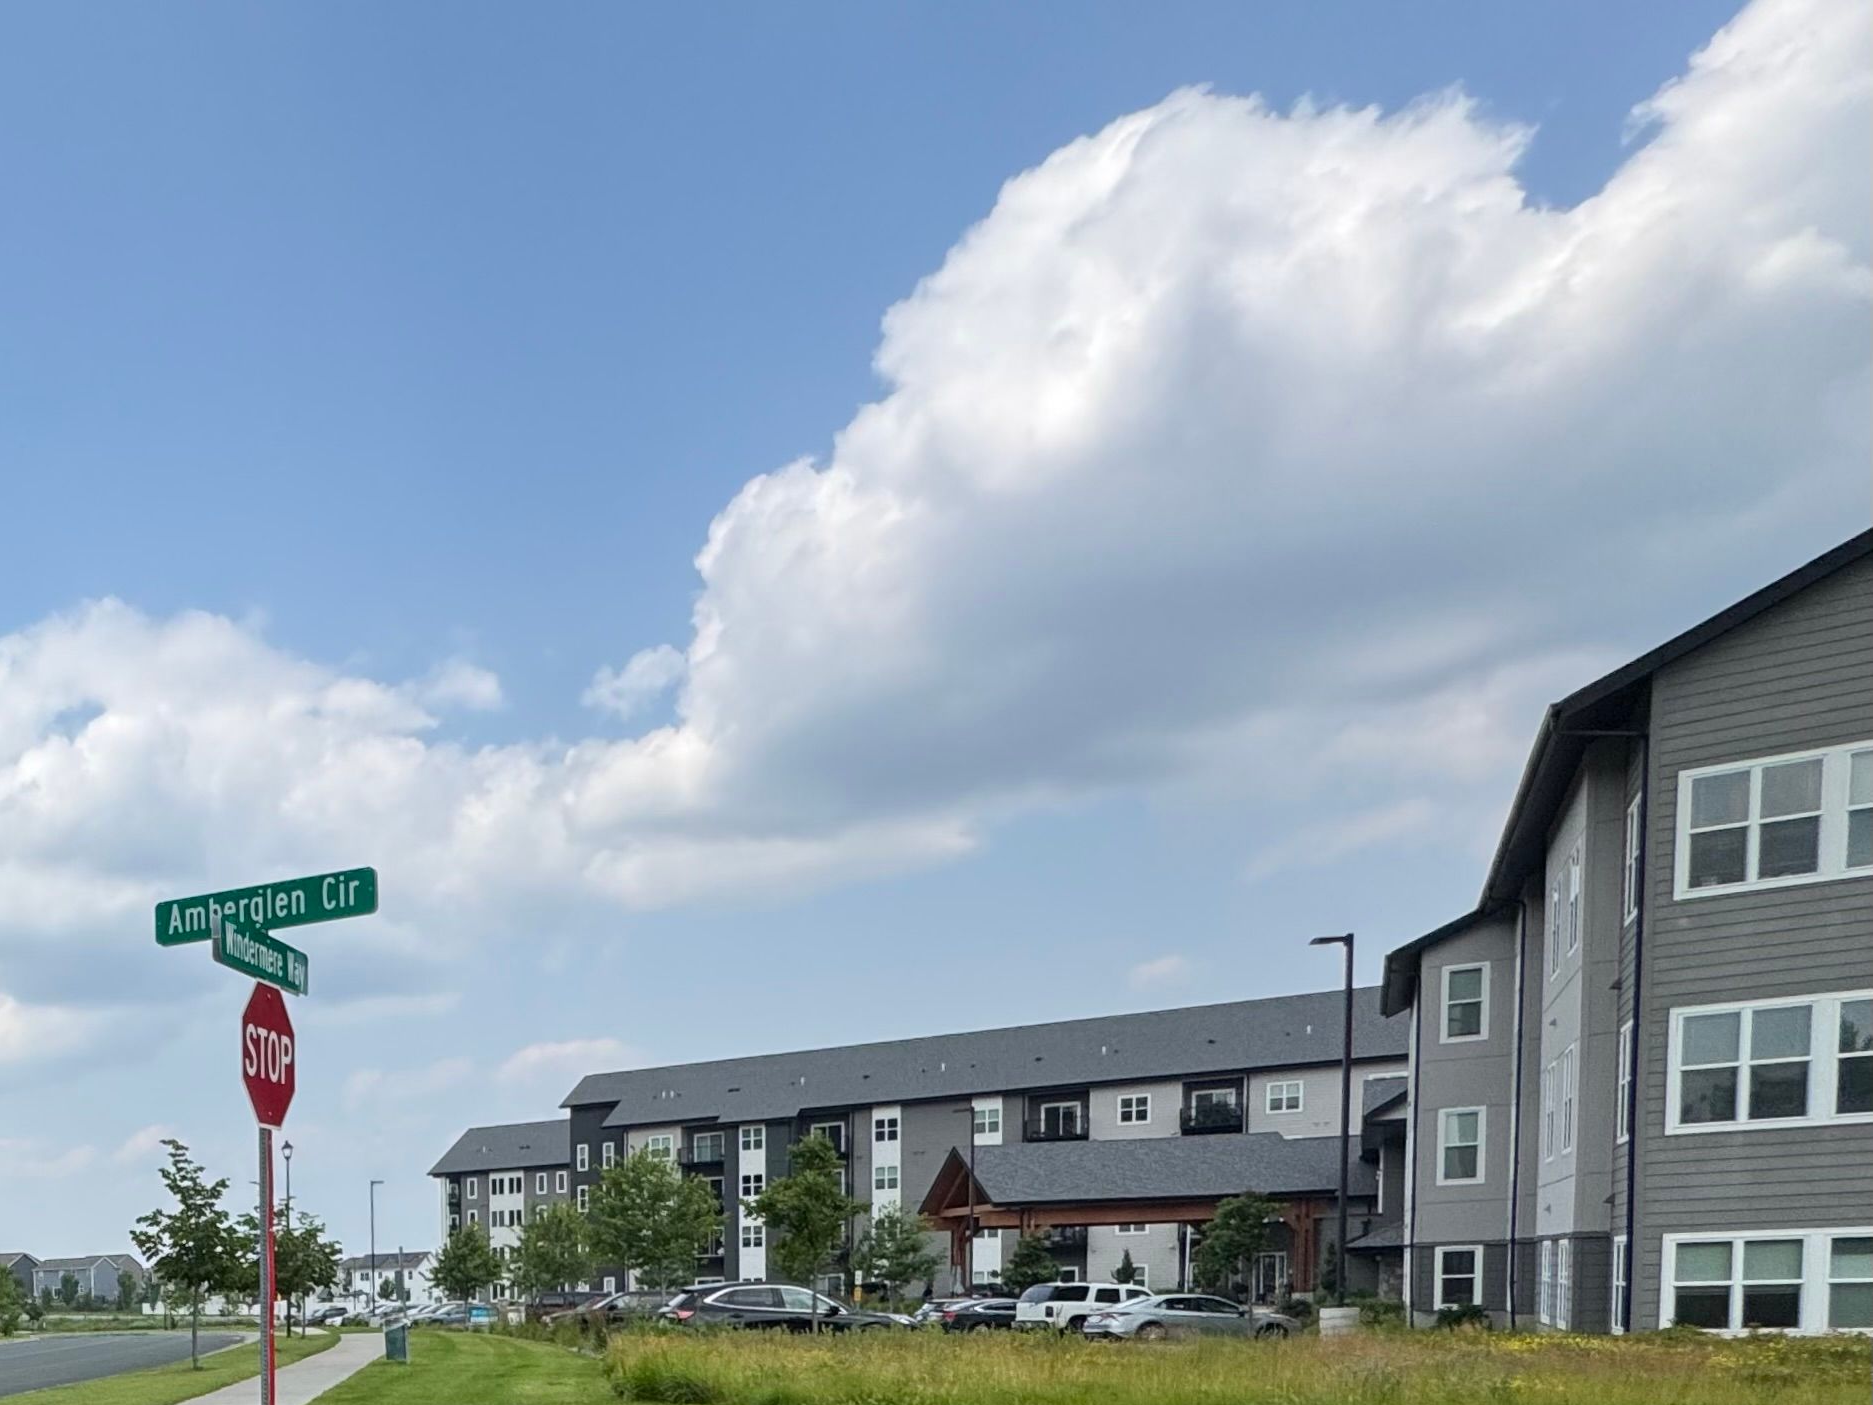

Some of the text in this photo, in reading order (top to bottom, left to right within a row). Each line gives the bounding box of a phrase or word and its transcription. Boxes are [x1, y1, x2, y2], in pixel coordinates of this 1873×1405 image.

[322, 876, 361, 911] Cir
[225, 920, 306, 992] Windermere Way
[245, 1023, 293, 1085] STOP
